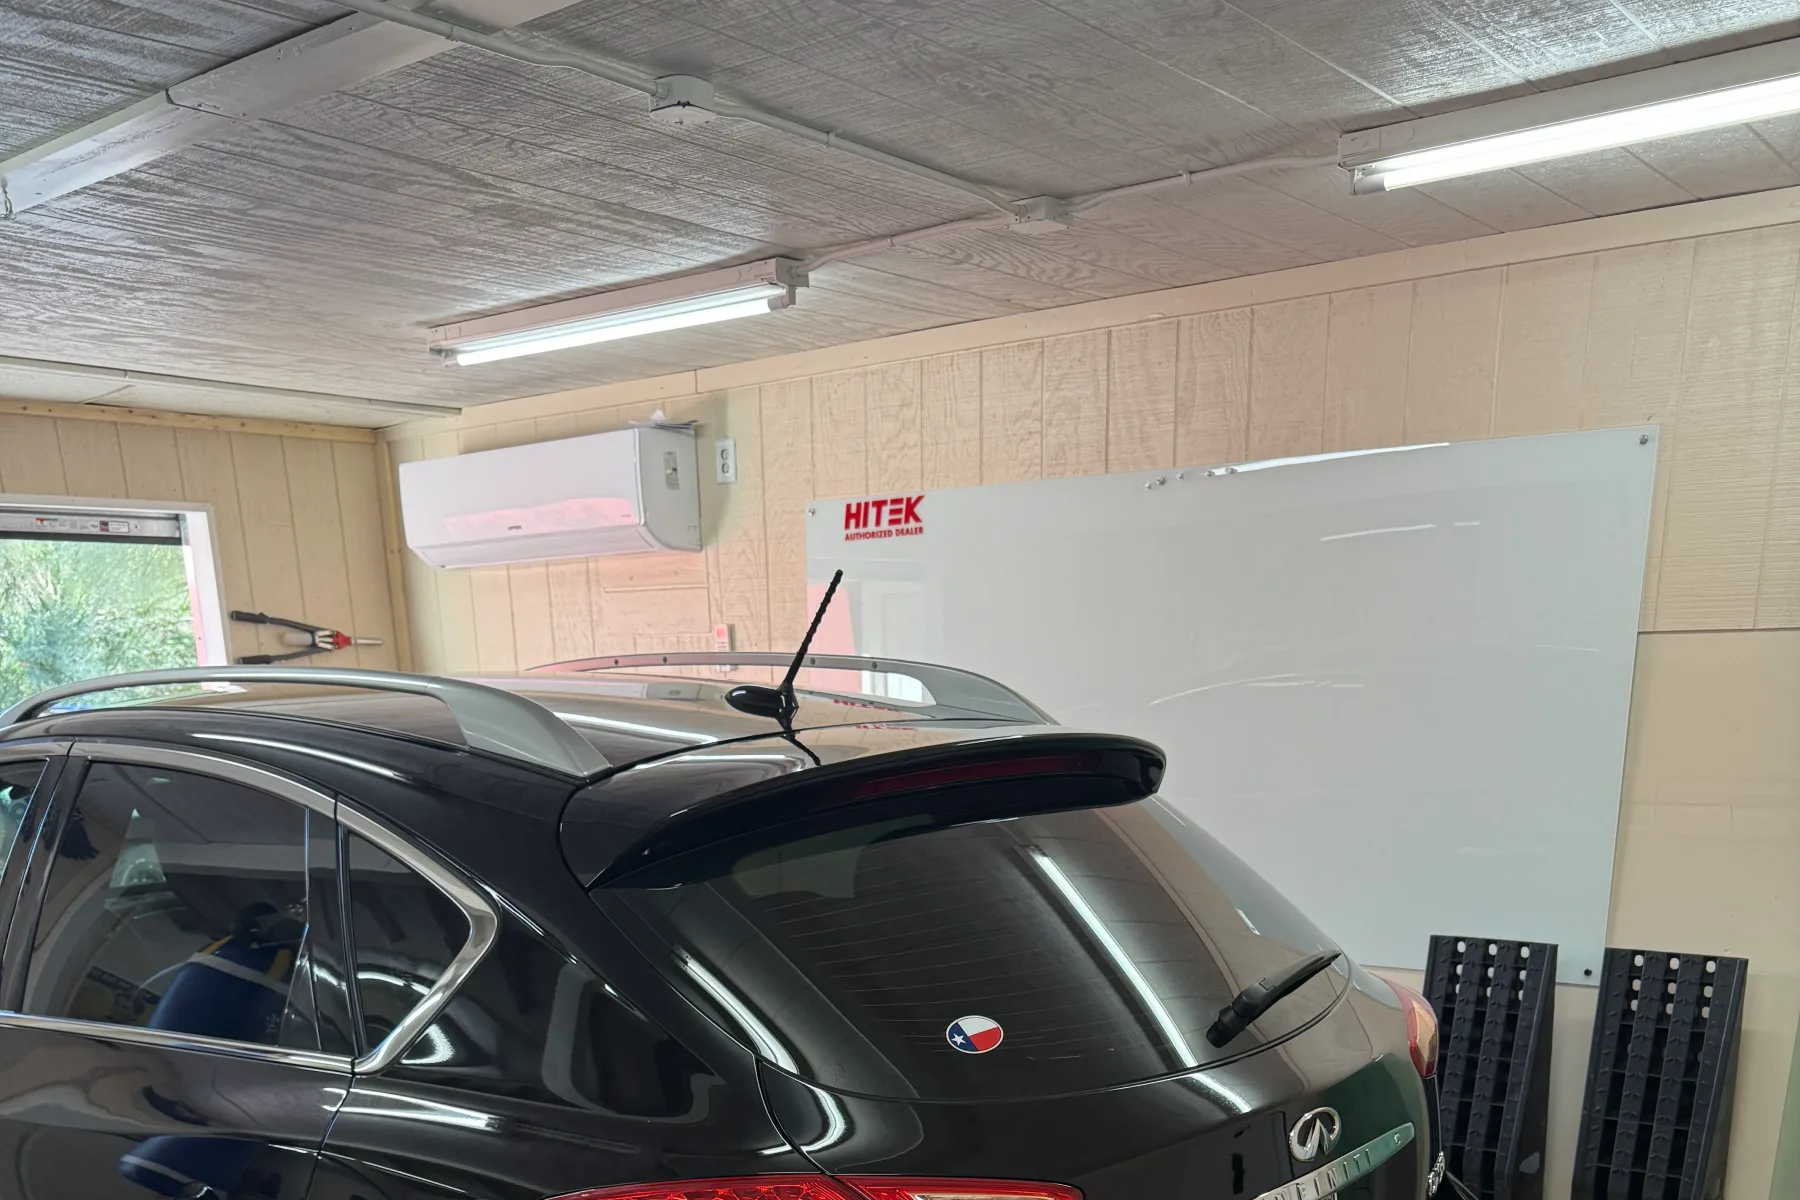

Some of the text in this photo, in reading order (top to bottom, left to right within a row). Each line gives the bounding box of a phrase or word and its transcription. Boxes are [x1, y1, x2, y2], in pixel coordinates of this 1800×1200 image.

[844, 495, 925, 530] HITEK
[844, 527, 924, 541] AUTHORIZED DEALER
